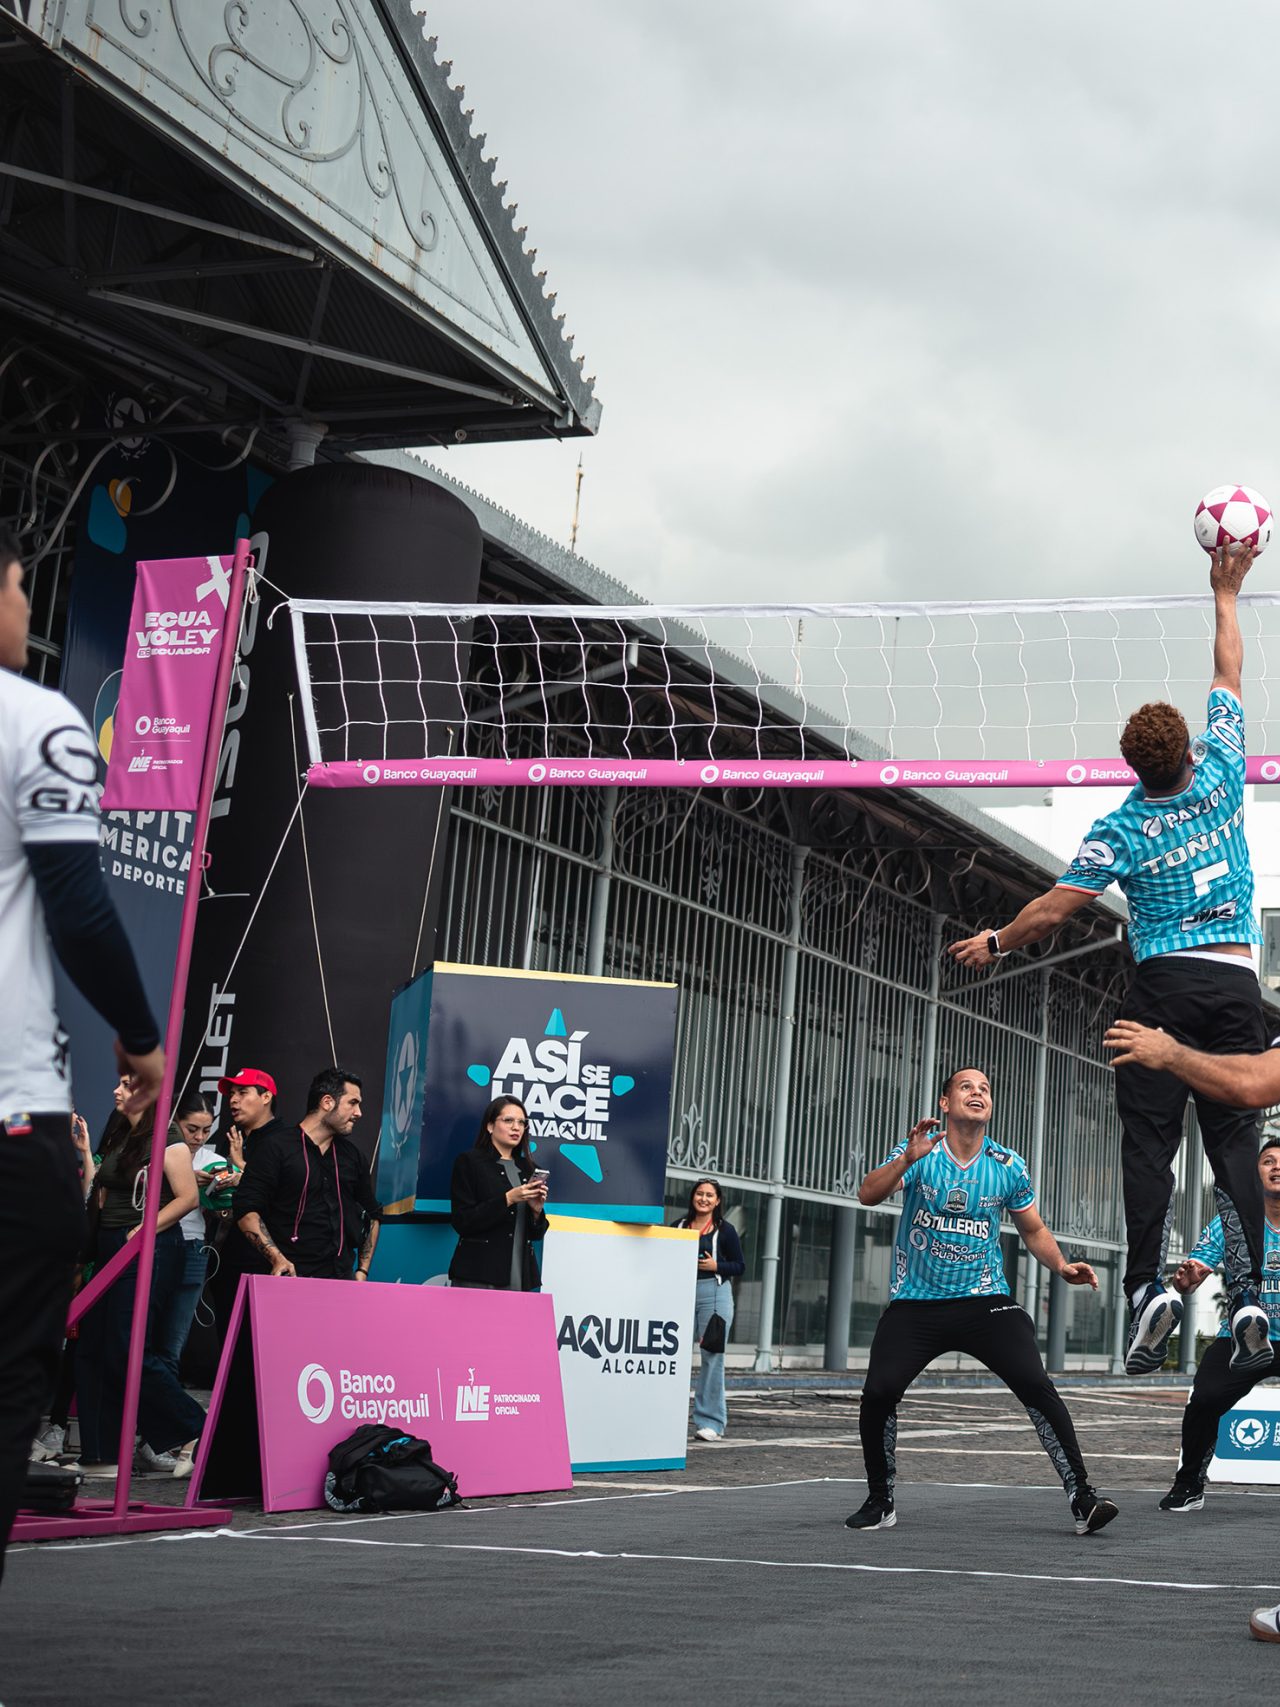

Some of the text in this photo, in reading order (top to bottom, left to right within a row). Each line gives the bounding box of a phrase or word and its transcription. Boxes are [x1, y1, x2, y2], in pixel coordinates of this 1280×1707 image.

[145, 611, 212, 628] ECUA
[135, 627, 219, 647] VÓLEY
[150, 647, 211, 656] ECUADOR
[152, 724, 190, 735] Guayaquil
[153, 717, 176, 725] Banco
[384, 768, 477, 782] Banco Guayaquil
[549, 768, 648, 782] Banco Guayaquil
[722, 769, 824, 783] Banco Guayaquil
[903, 769, 1009, 783] Banco Guayaquil
[1090, 768, 1131, 779] Banco
[1164, 780, 1228, 830] PAYJOY
[1141, 803, 1244, 875] TOÑITO
[112, 860, 185, 896] DEPORTE
[493, 1030, 611, 1086] ASÍ SE
[528, 1119, 607, 1141] AYAQUIL
[913, 1209, 989, 1240] ASTILLEROS
[932, 1238, 968, 1253] Banco
[557, 1314, 680, 1359] AQUILES
[602, 1358, 677, 1375] ALCALDE
[340, 1369, 396, 1394] Banco
[494, 1394, 541, 1403] PATROCINADOR
[341, 1393, 430, 1424] Guayaquil
[495, 1405, 520, 1415] OFICIAL
